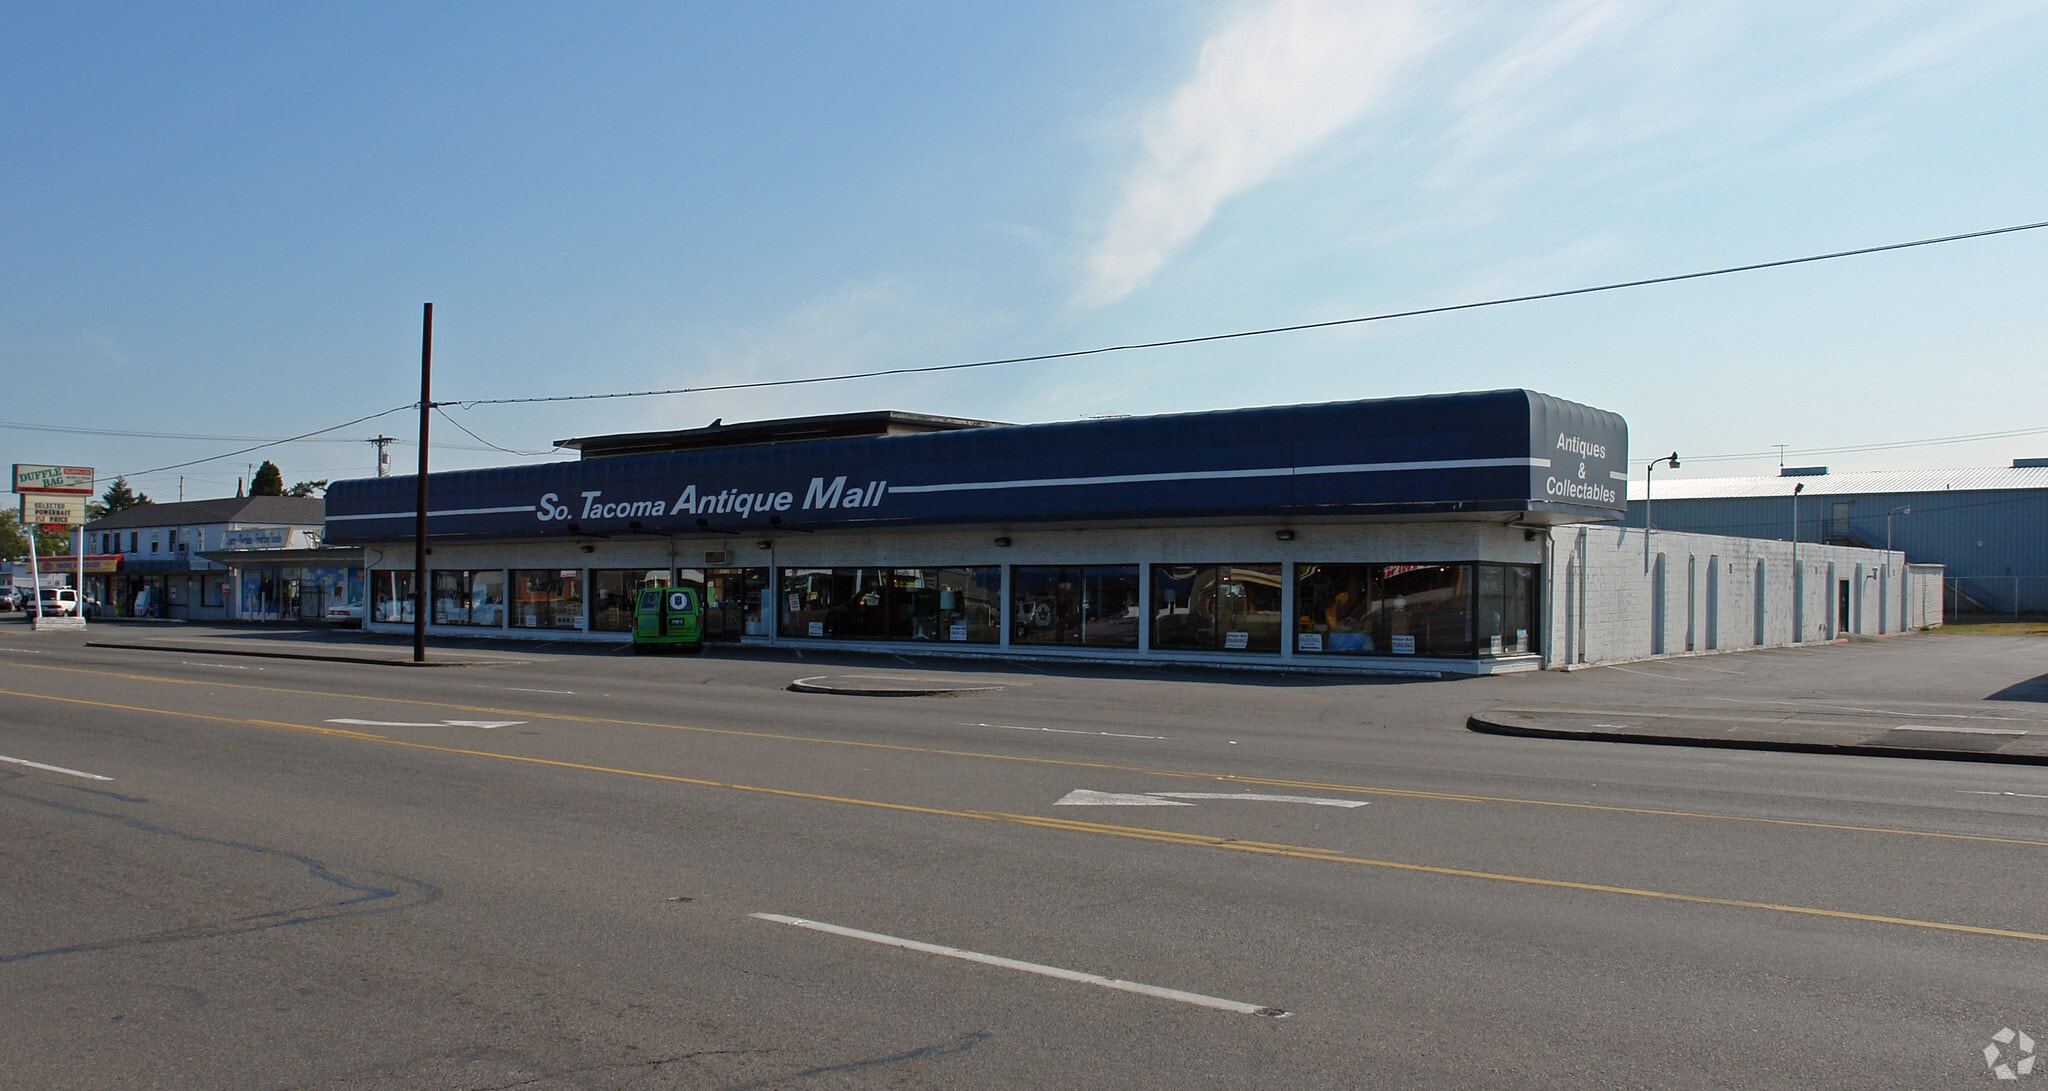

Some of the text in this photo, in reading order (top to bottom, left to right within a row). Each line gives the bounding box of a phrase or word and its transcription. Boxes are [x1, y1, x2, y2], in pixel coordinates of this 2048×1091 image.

[1556, 432, 1606, 459] Antiques
[19, 468, 62, 482] DUFFLE
[1578, 462, 1587, 480] &
[42, 477, 64, 487] BAG
[1546, 476, 1616, 503] Collectables
[537, 476, 888, 521] So. Tacoma Antique Mall
[42, 524, 65, 532] OPEN
